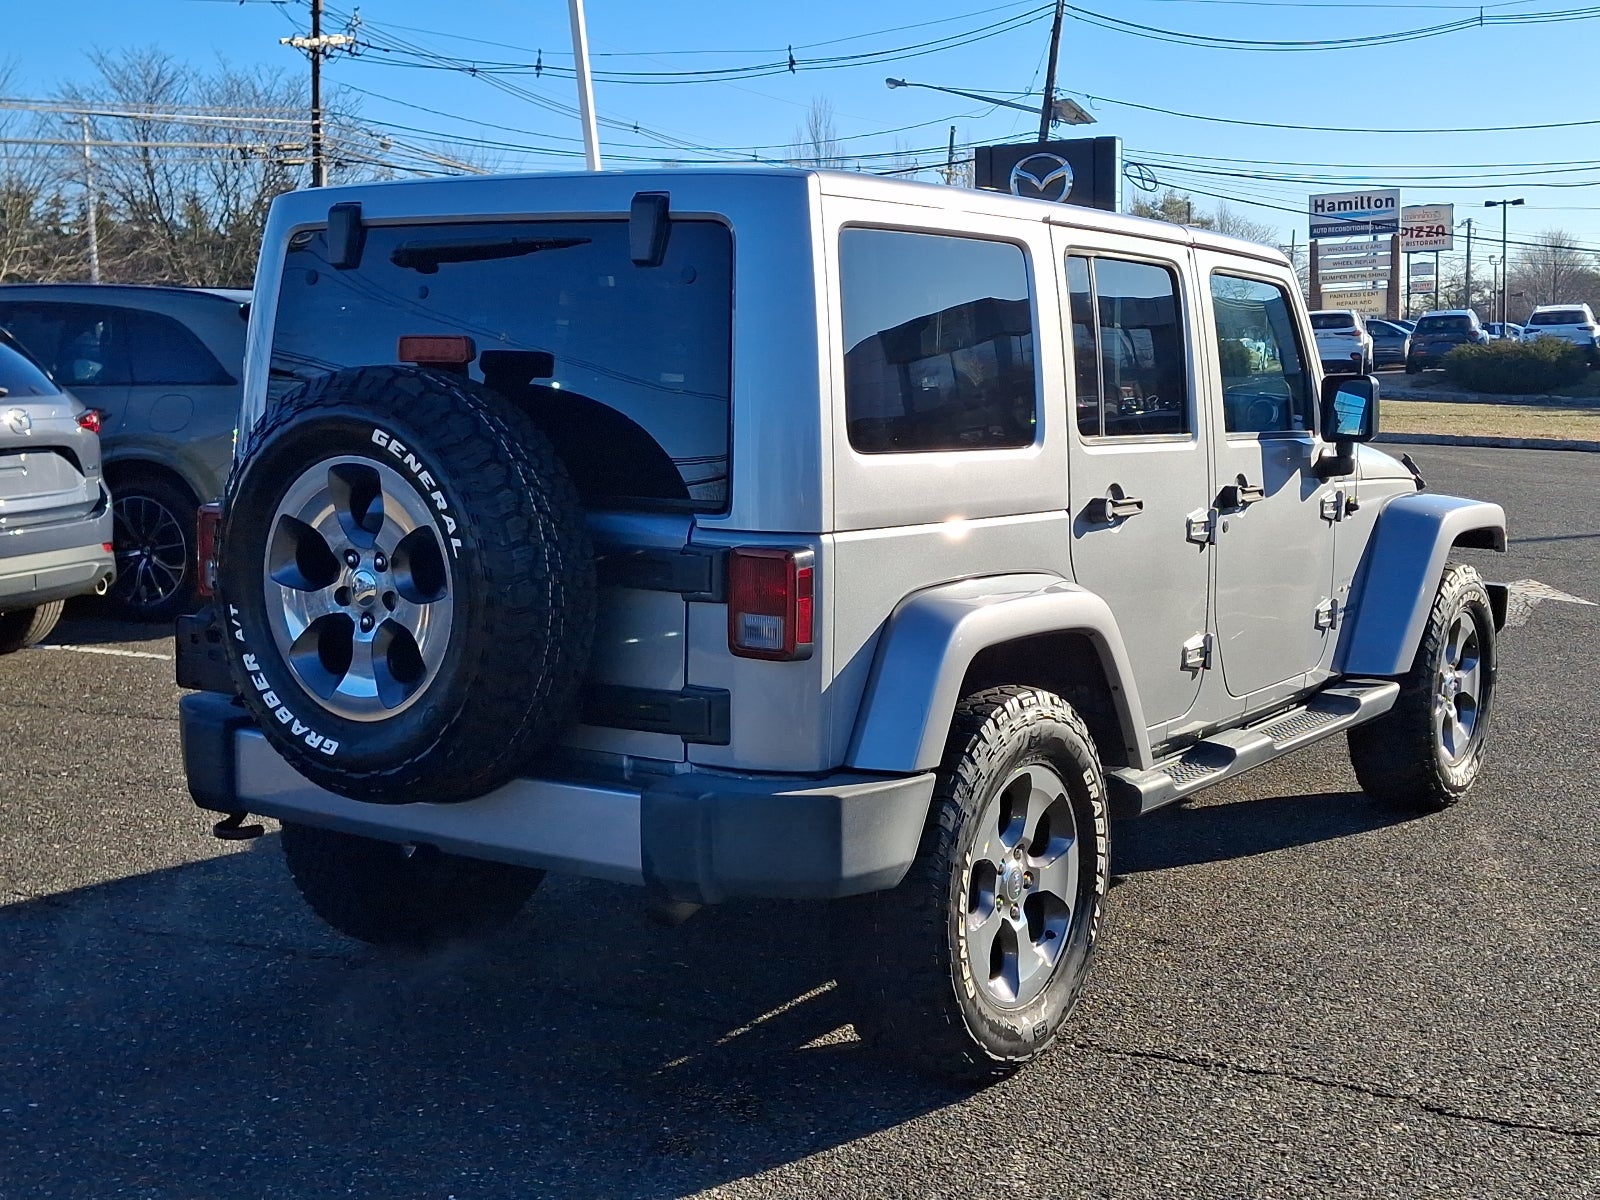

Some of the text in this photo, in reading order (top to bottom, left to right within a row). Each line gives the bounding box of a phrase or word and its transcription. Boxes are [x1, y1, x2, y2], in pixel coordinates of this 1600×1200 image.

[1314, 195, 1395, 213] Hamilton
[1400, 224, 1446, 238] PIZZA
[1406, 239, 1446, 247] RISTORANTE
[1330, 291, 1361, 299] PAINTLESS
[371, 428, 462, 559] GENERAL
[229, 603, 340, 756] GRABBER A/T
[1082, 767, 1107, 942] GRABBER A/T
[958, 851, 976, 999] GENERAL
